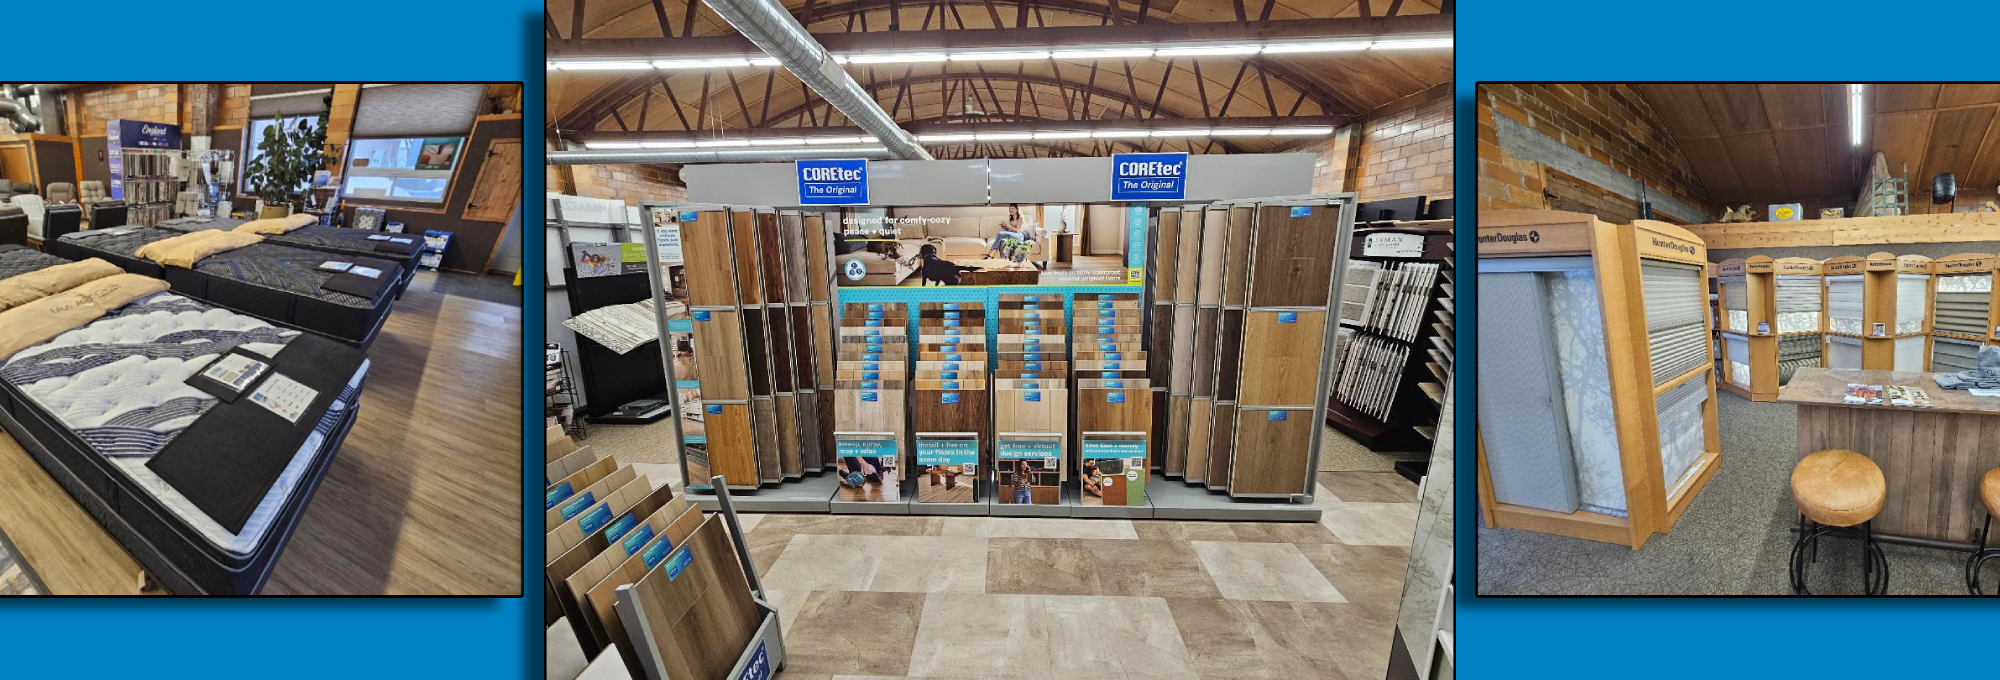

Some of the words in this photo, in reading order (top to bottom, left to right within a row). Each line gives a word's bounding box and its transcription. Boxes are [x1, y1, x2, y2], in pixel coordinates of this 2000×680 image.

[142, 124, 167, 136] England
[803, 167, 862, 181] COREtec
[1119, 161, 1182, 176] COREtec
[809, 186, 824, 194] The
[826, 185, 857, 196] Original
[1123, 181, 1138, 189] The
[1141, 180, 1175, 190] Original
[842, 216, 882, 225] designed
[885, 216, 898, 224] for
[900, 216, 951, 225] comfy-cozy
[879, 228, 902, 236] quiet
[1478, 232, 1528, 244] unterDouglas
[1652, 237, 1690, 253] HunterDouglas
